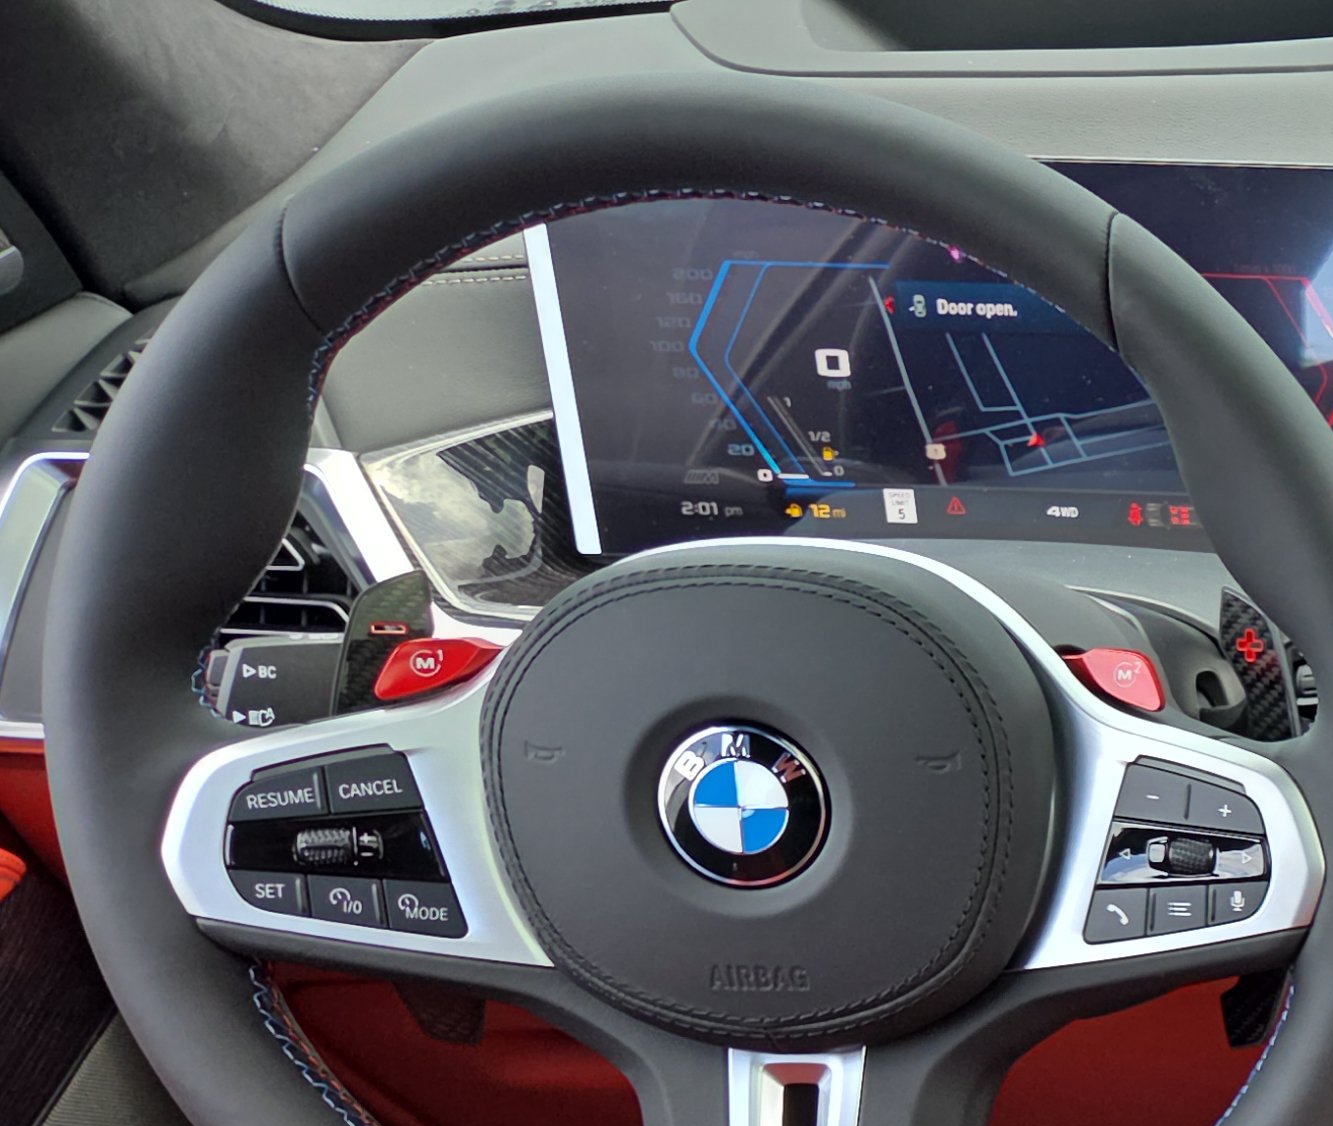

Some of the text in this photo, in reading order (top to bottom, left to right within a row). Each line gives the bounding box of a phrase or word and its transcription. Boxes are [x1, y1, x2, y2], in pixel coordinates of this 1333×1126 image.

[937, 298, 1017, 318] Door open.
[814, 348, 851, 377] 0
[827, 379, 852, 391] mph
[728, 443, 755, 457] 20
[681, 501, 743, 518] 2:01 pm
[809, 503, 846, 518] 12 mi
[898, 508, 906, 520] 5
[1047, 505, 1079, 518] 4WD
[258, 665, 277, 679] BC
[675, 733, 806, 783] BMW
[245, 785, 314, 810] RESUME
[338, 778, 403, 800] CANCEL
[255, 883, 285, 900] SET
[404, 905, 448, 922] MODE
[709, 965, 811, 993] AIRBAG
